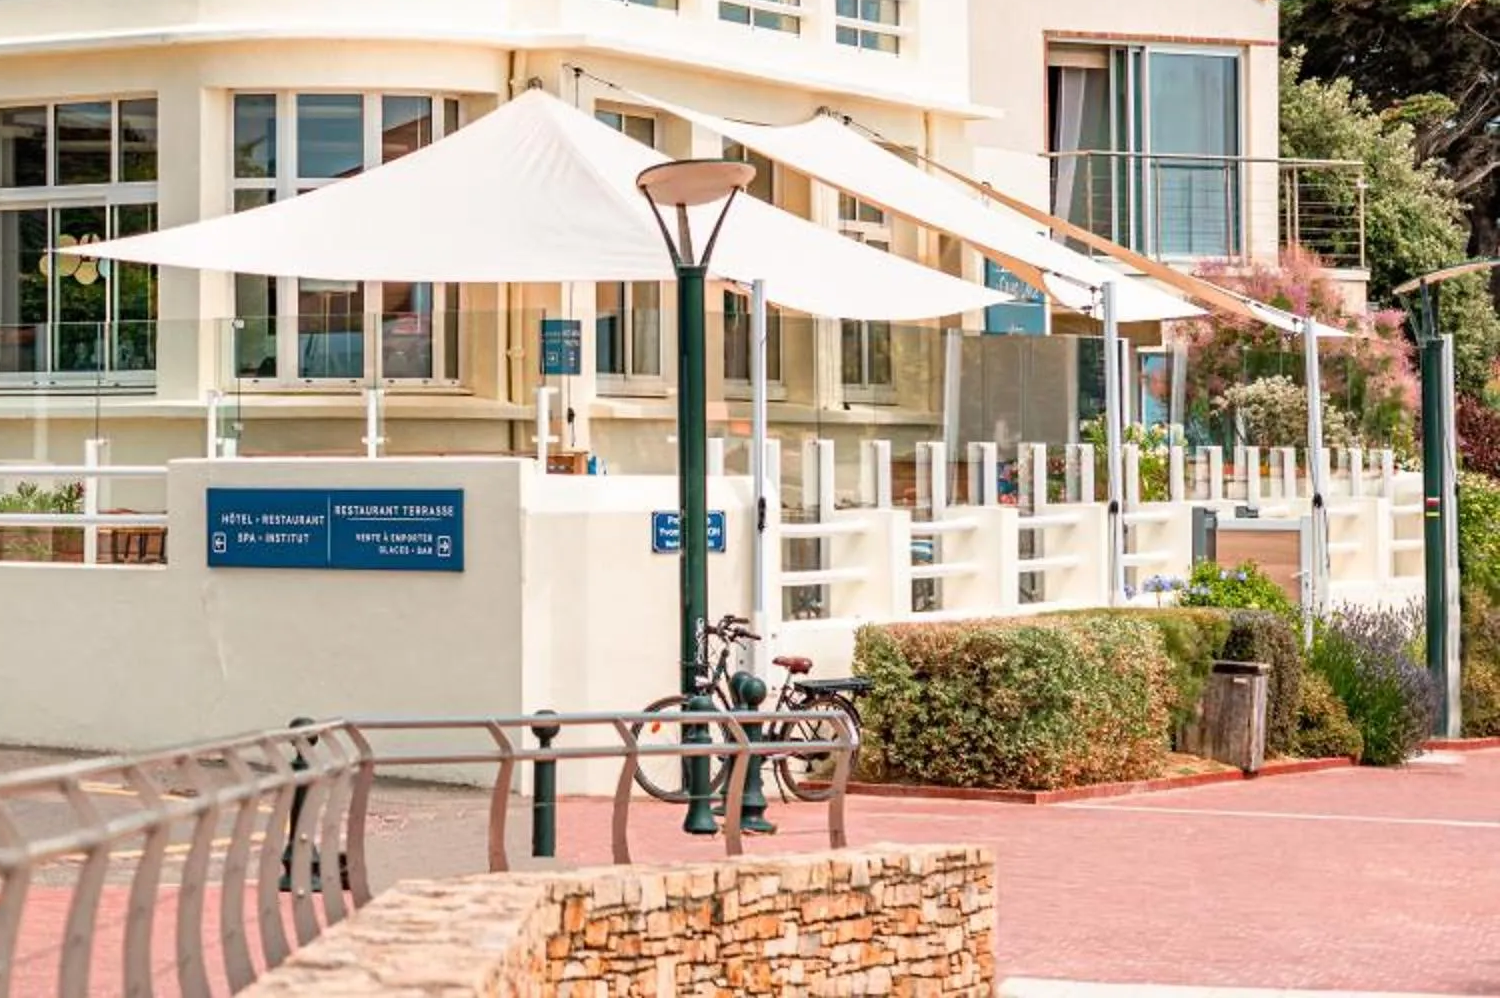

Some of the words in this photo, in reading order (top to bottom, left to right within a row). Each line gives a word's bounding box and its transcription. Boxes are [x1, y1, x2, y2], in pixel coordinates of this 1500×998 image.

[335, 505, 399, 516] RESTAURANT
[402, 505, 454, 517] TERRASSE
[221, 512, 253, 525] HÔTEL
[261, 514, 325, 526] RESTAURANT
[237, 532, 256, 543] SPA
[265, 533, 309, 544] INSTITUT
